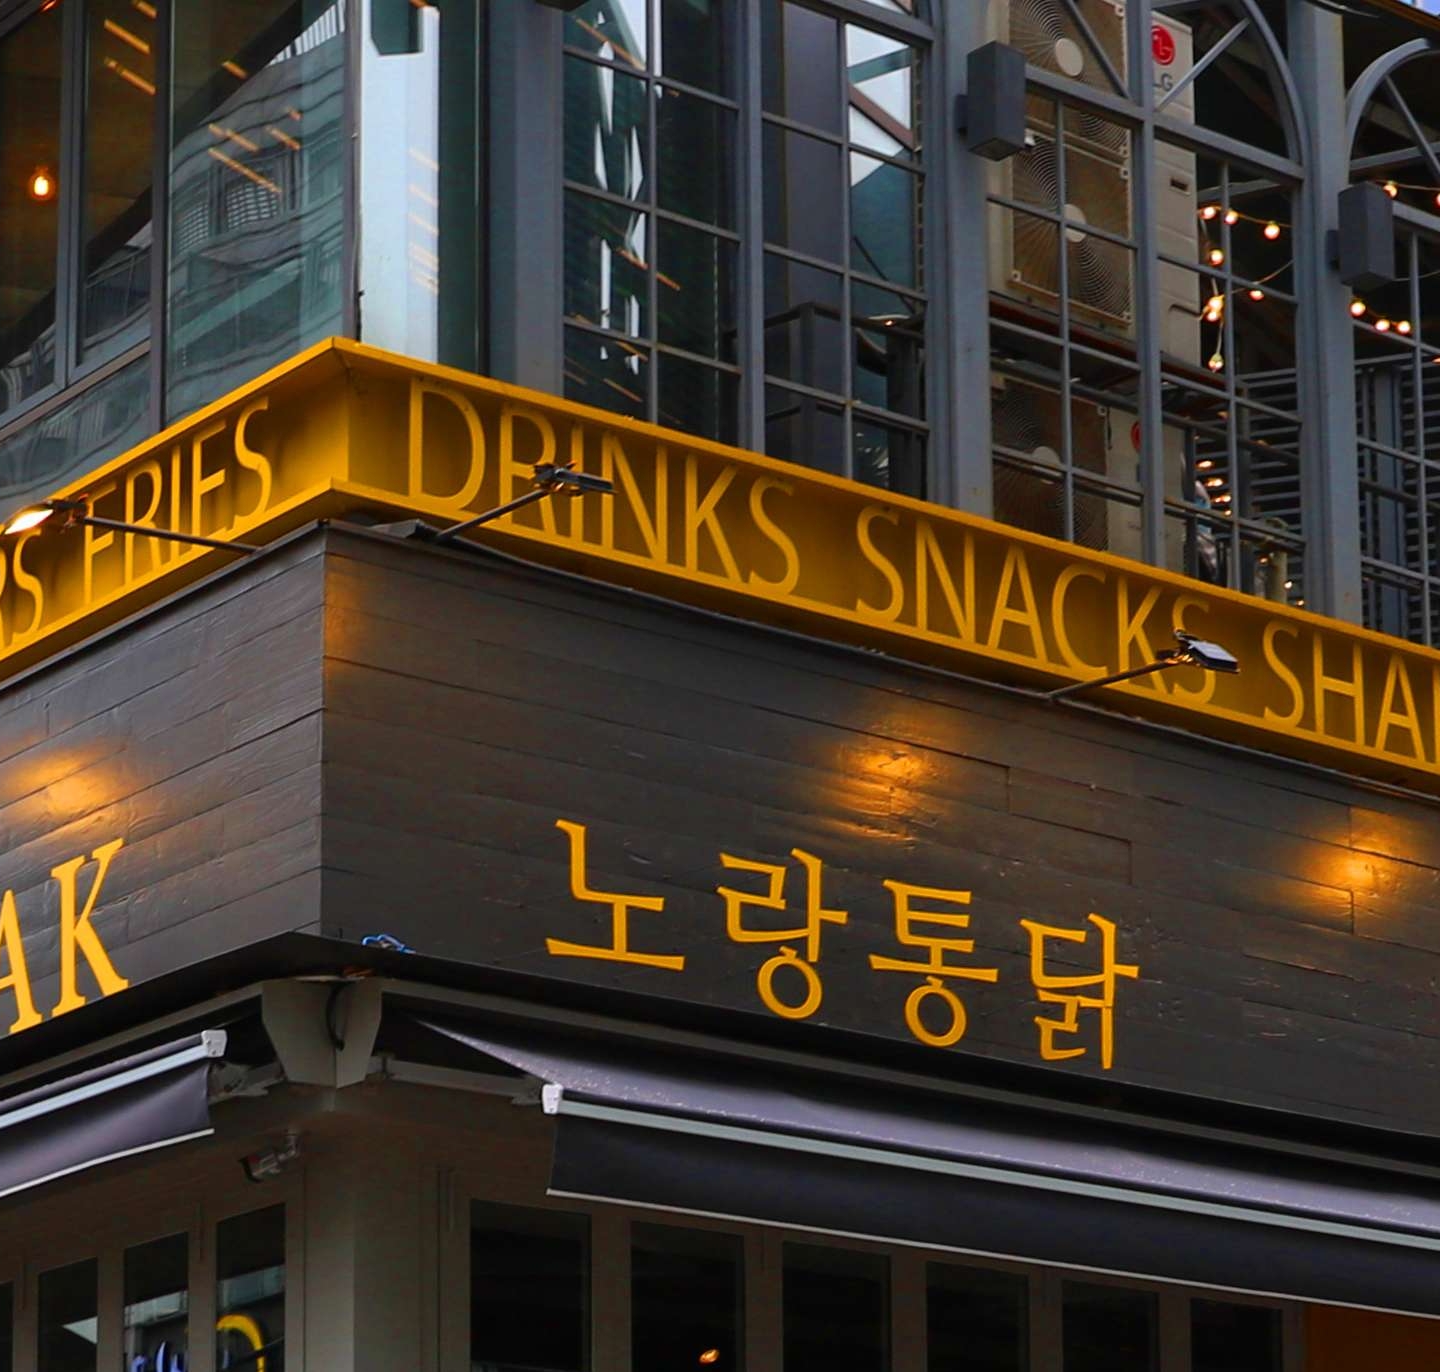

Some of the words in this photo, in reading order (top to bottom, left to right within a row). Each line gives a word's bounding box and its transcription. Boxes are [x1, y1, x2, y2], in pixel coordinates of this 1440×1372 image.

[83, 399, 272, 606] FRIES
[408, 384, 801, 597] DRINKS
[856, 505, 1217, 707] SNACKS
[545, 819, 1140, 1071] 노랑통닭
